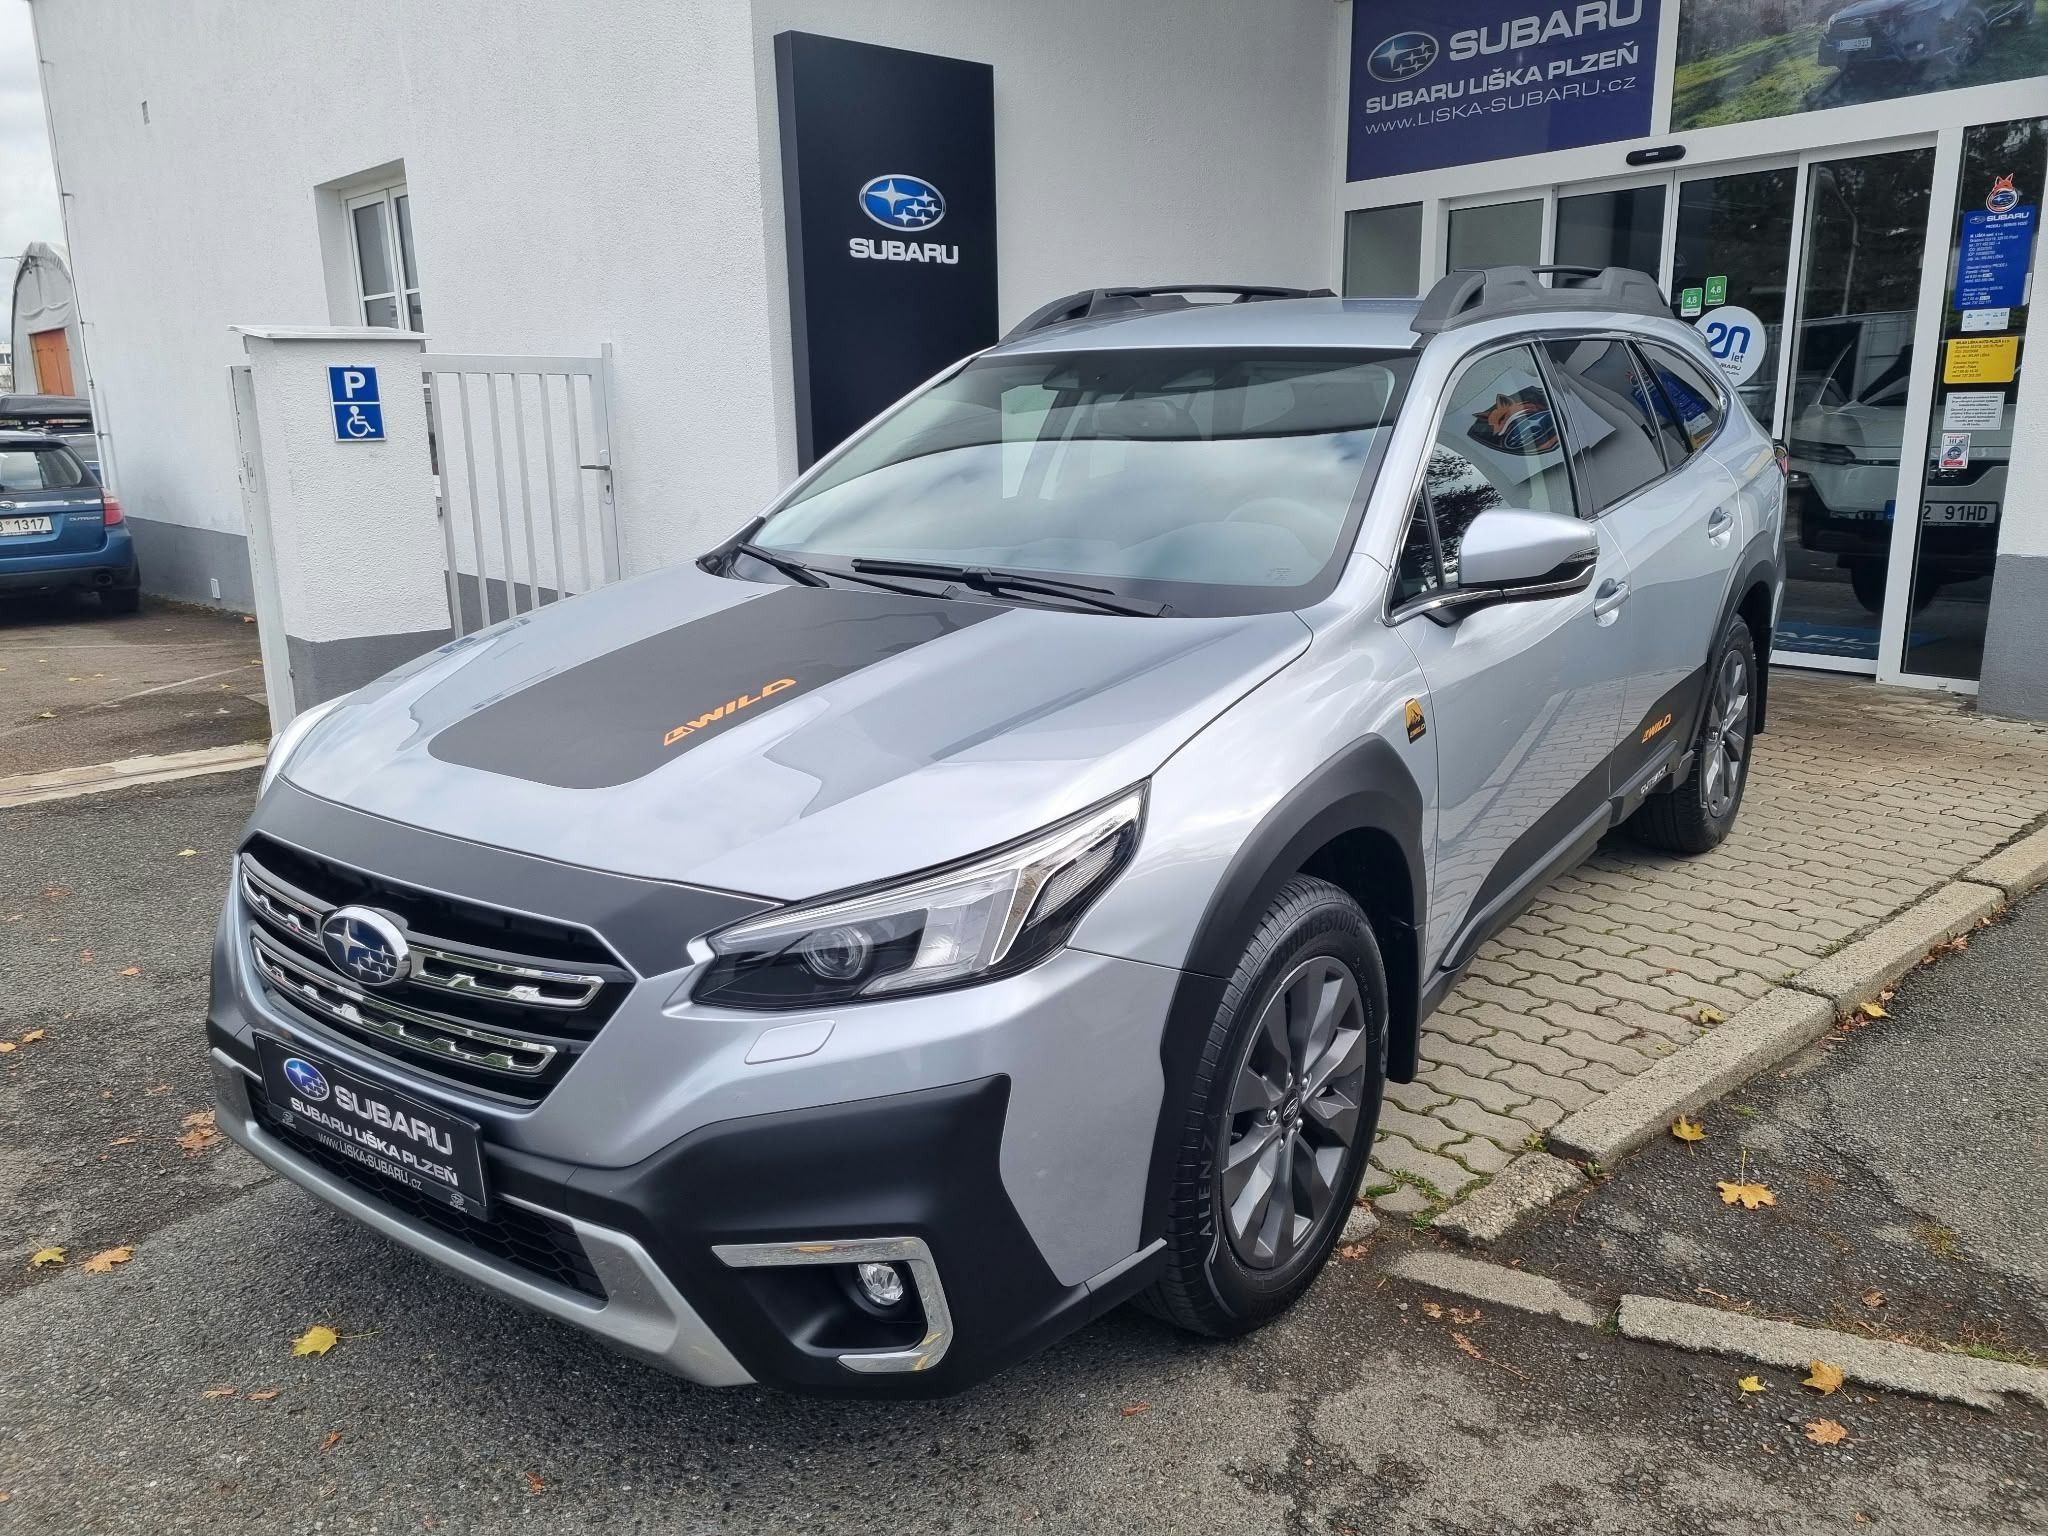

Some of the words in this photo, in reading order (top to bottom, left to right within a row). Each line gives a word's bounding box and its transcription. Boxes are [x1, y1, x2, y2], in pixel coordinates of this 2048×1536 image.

[1449, 0, 1643, 61] SUBARU
[1366, 80, 1465, 114] SUBARU
[1469, 66, 1543, 96] LIŠKA
[1548, 41, 1639, 80] PLZEŇ
[1986, 212, 2030, 222] SUBARU
[849, 237, 959, 264] SUBARU
[1730, 352, 1745, 364] let
[343, 371, 366, 399] P
[1944, 505, 1988, 521] 91HD
[334, 1085, 453, 1156] SUBARU
[290, 1097, 352, 1137] SUBARU
[354, 1128, 401, 1161] LIŠKA
[402, 1152, 459, 1187] PLZEŇ
